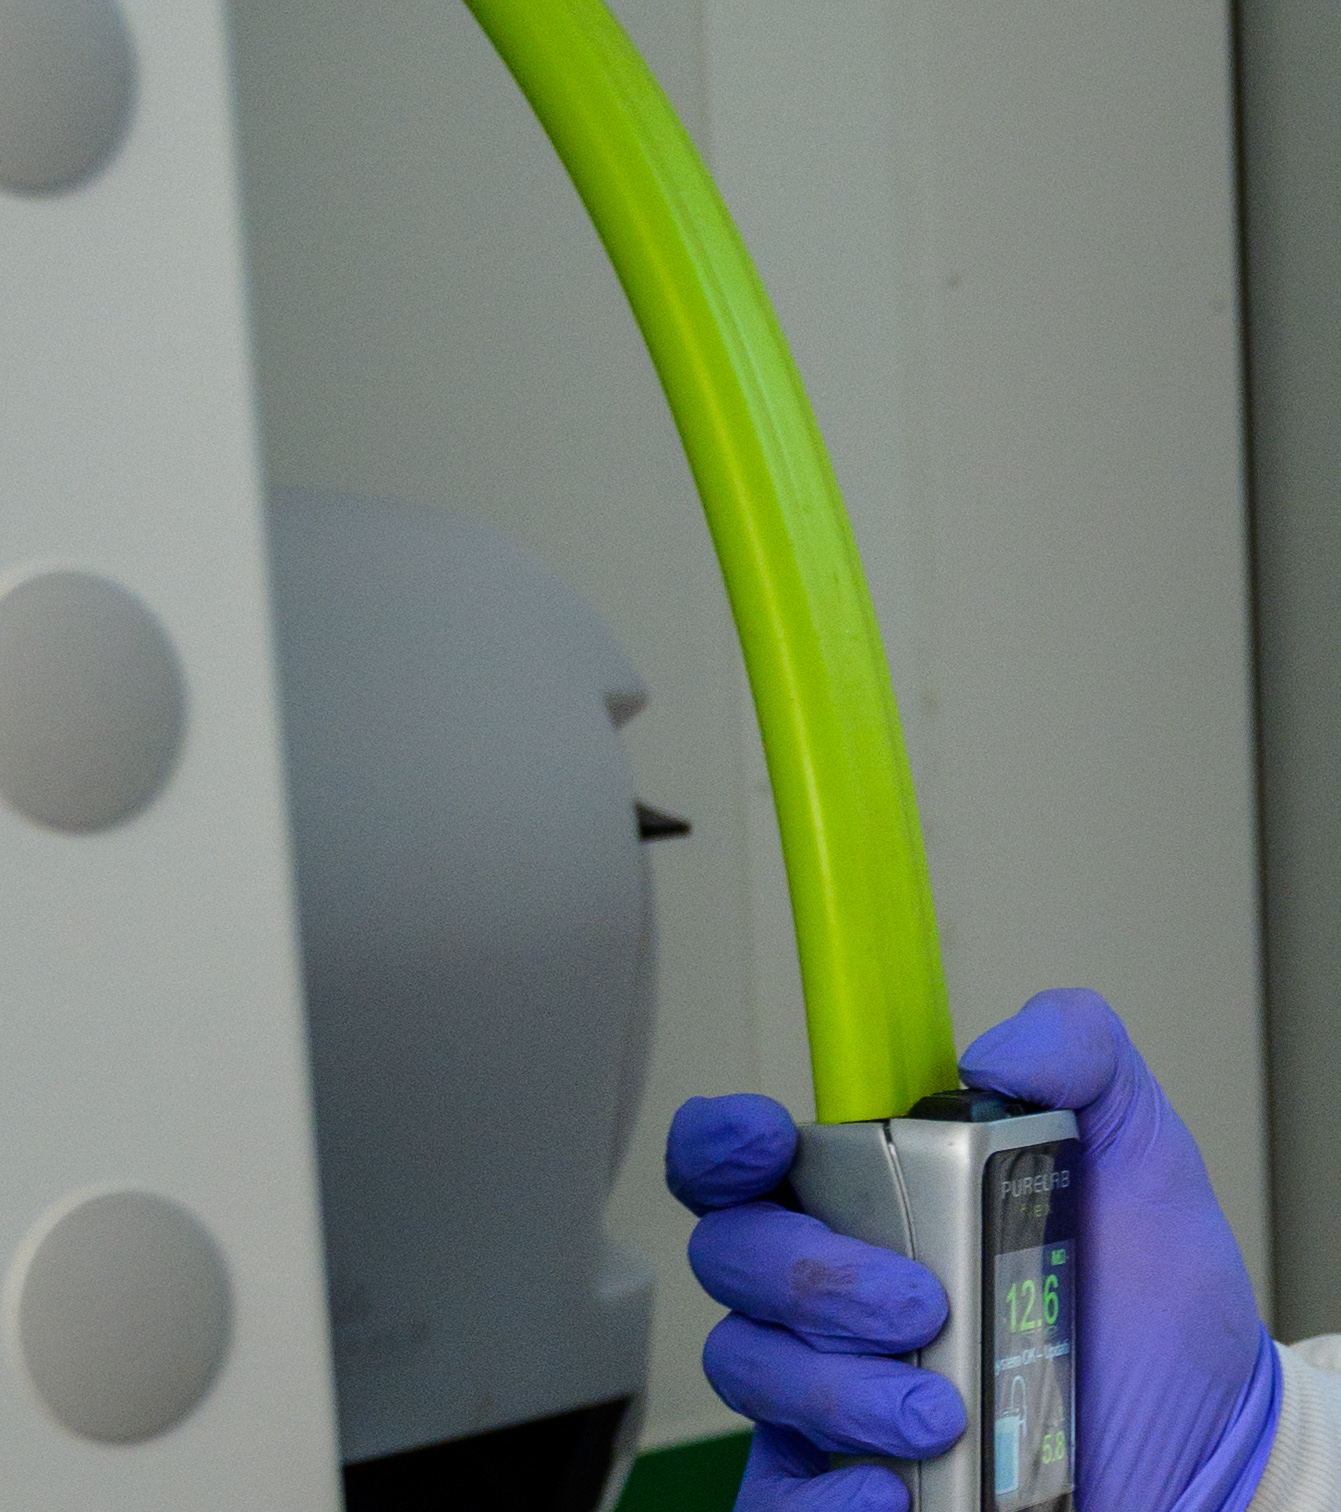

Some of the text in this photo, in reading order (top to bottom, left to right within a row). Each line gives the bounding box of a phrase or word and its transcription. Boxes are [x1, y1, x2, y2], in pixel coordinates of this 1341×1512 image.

[1001, 1170, 1070, 1199] PURELAB
[1005, 1274, 1059, 1333] 12.6
[1041, 1431, 1065, 1465] 5.8
